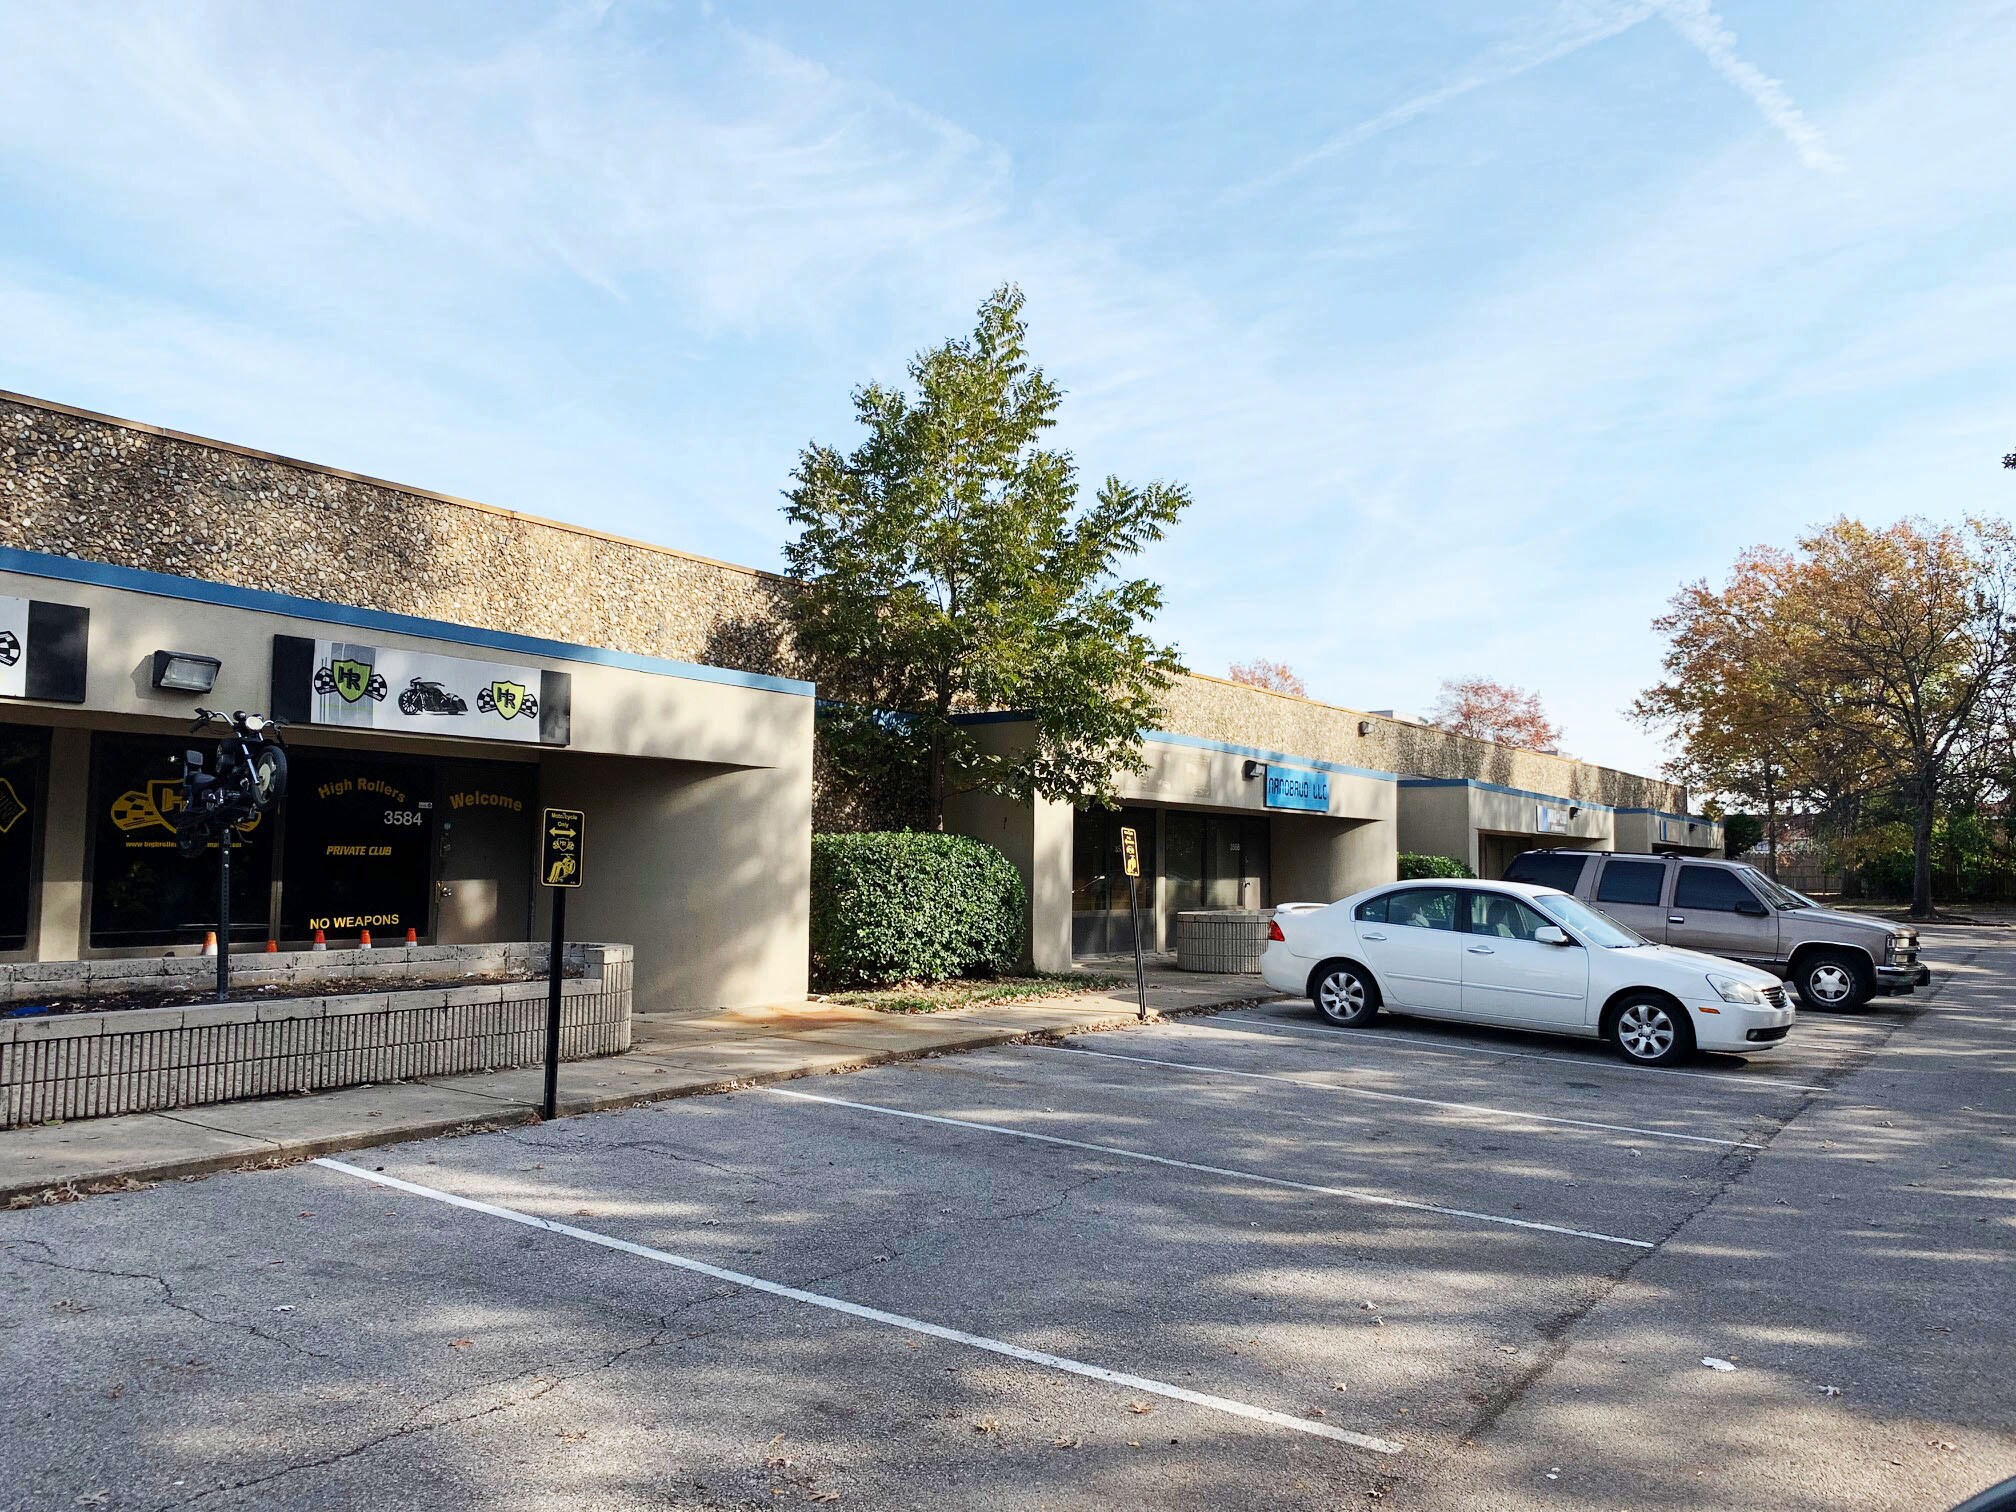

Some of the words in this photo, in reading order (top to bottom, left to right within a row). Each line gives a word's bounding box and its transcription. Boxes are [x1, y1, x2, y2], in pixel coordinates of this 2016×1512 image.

[337, 665, 361, 691] HR
[496, 686, 517, 709] HR
[318, 778, 353, 799] High
[357, 777, 406, 803] Rollers
[1268, 777, 1309, 798] NANOBAUD
[1313, 783, 1327, 800] LLC
[449, 790, 524, 812] Welcome
[383, 810, 423, 827] 3584
[326, 845, 367, 856] PRIVATE
[368, 845, 393, 856] CLUB
[309, 917, 330, 930] NO
[333, 913, 399, 929] WEAPONS
